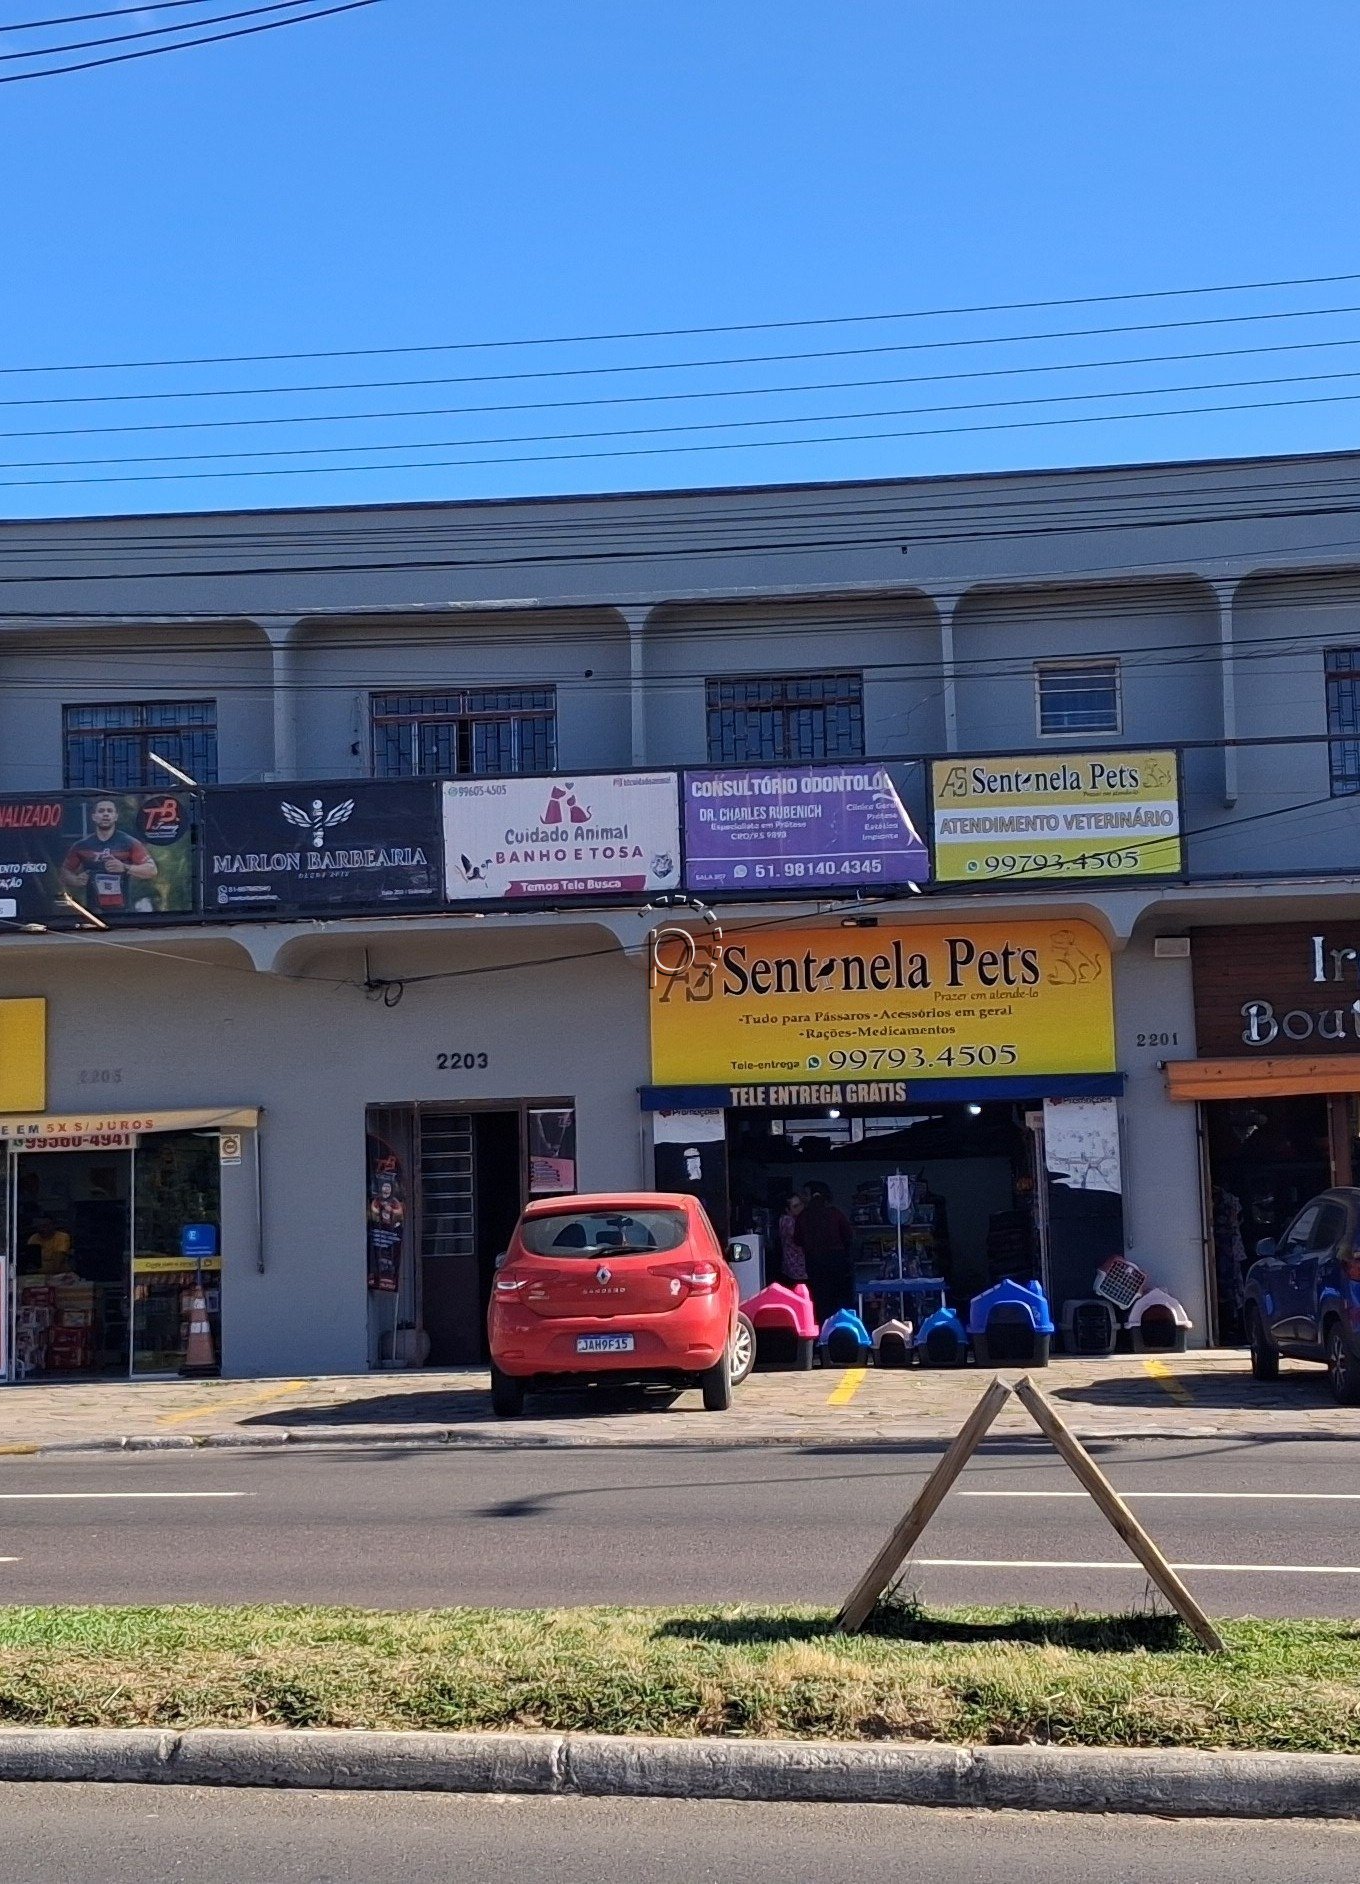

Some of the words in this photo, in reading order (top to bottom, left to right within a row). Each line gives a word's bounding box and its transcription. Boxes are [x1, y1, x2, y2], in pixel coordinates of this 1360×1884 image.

[691, 775, 798, 798] CONSULTÓRIO
[699, 808, 718, 821] DR.
[719, 806, 767, 821] CHARLES
[769, 804, 822, 819] RUBENICH
[940, 813, 1060, 835] ATENDIMENTO
[1063, 806, 1174, 831] VETERINÁRIO
[504, 825, 569, 845] Cuidado
[574, 824, 629, 842] Animal
[214, 852, 300, 874] MARLON
[307, 847, 428, 870] BARBEARIA
[495, 848, 567, 865] BANHO
[574, 847, 583, 861] E
[589, 845, 644, 860] TOSA
[985, 850, 1140, 874] 99793.4505
[695, 873, 714, 881] SALA
[784, 859, 882, 877] 98140.4345
[520, 881, 560, 892] Temos
[562, 880, 585, 891] Tele
[587, 879, 622, 890] Busca
[934, 990, 967, 1002] Prazer
[970, 991, 987, 1000] em
[782, 1015, 811, 1026] para
[815, 1011, 871, 1023] Pássaros
[954, 1008, 976, 1018] em
[979, 1005, 1013, 1019] geral
[1135, 1031, 1180, 1048] 2201
[436, 1051, 490, 1070] 2203
[730, 1060, 801, 1072] Tele-entrega
[828, 1044, 1018, 1071] 99793.4505
[729, 1086, 767, 1107] TELE
[769, 1084, 841, 1106] ENTREGA
[845, 1081, 908, 1104] GRÁTIS
[16, 1123, 41, 1134] EM
[46, 1122, 67, 1134] 5X
[74, 1121, 91, 1133] S/
[95, 1118, 155, 1132] JUROS
[581, 1338, 628, 1351] JAH9F15
